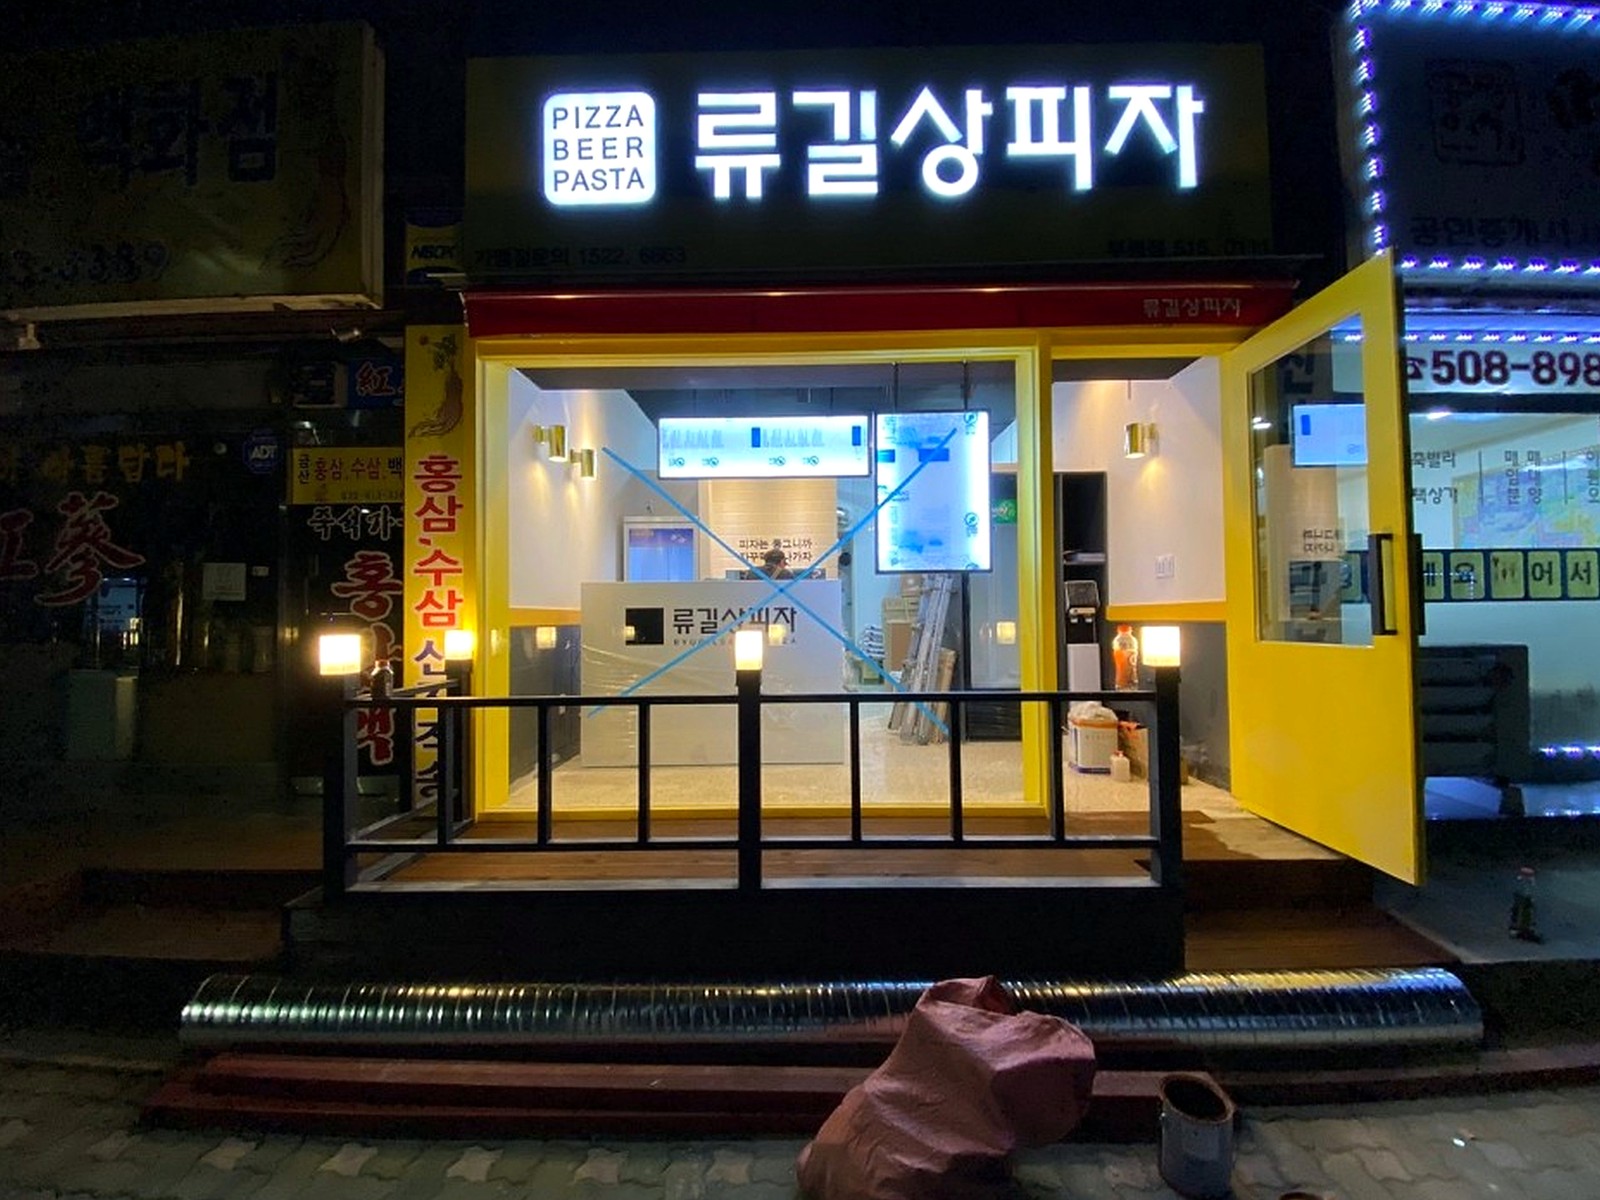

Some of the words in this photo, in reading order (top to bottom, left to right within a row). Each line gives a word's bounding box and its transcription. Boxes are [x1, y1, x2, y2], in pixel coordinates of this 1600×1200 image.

[552, 104, 644, 130] PIZZA
[553, 136, 644, 161] BEER
[695, 86, 1204, 200] 류길상피자
[553, 166, 645, 192] PASTA
[1142, 297, 1241, 318] 류길상피자
[250, 444, 278, 460] ADT
